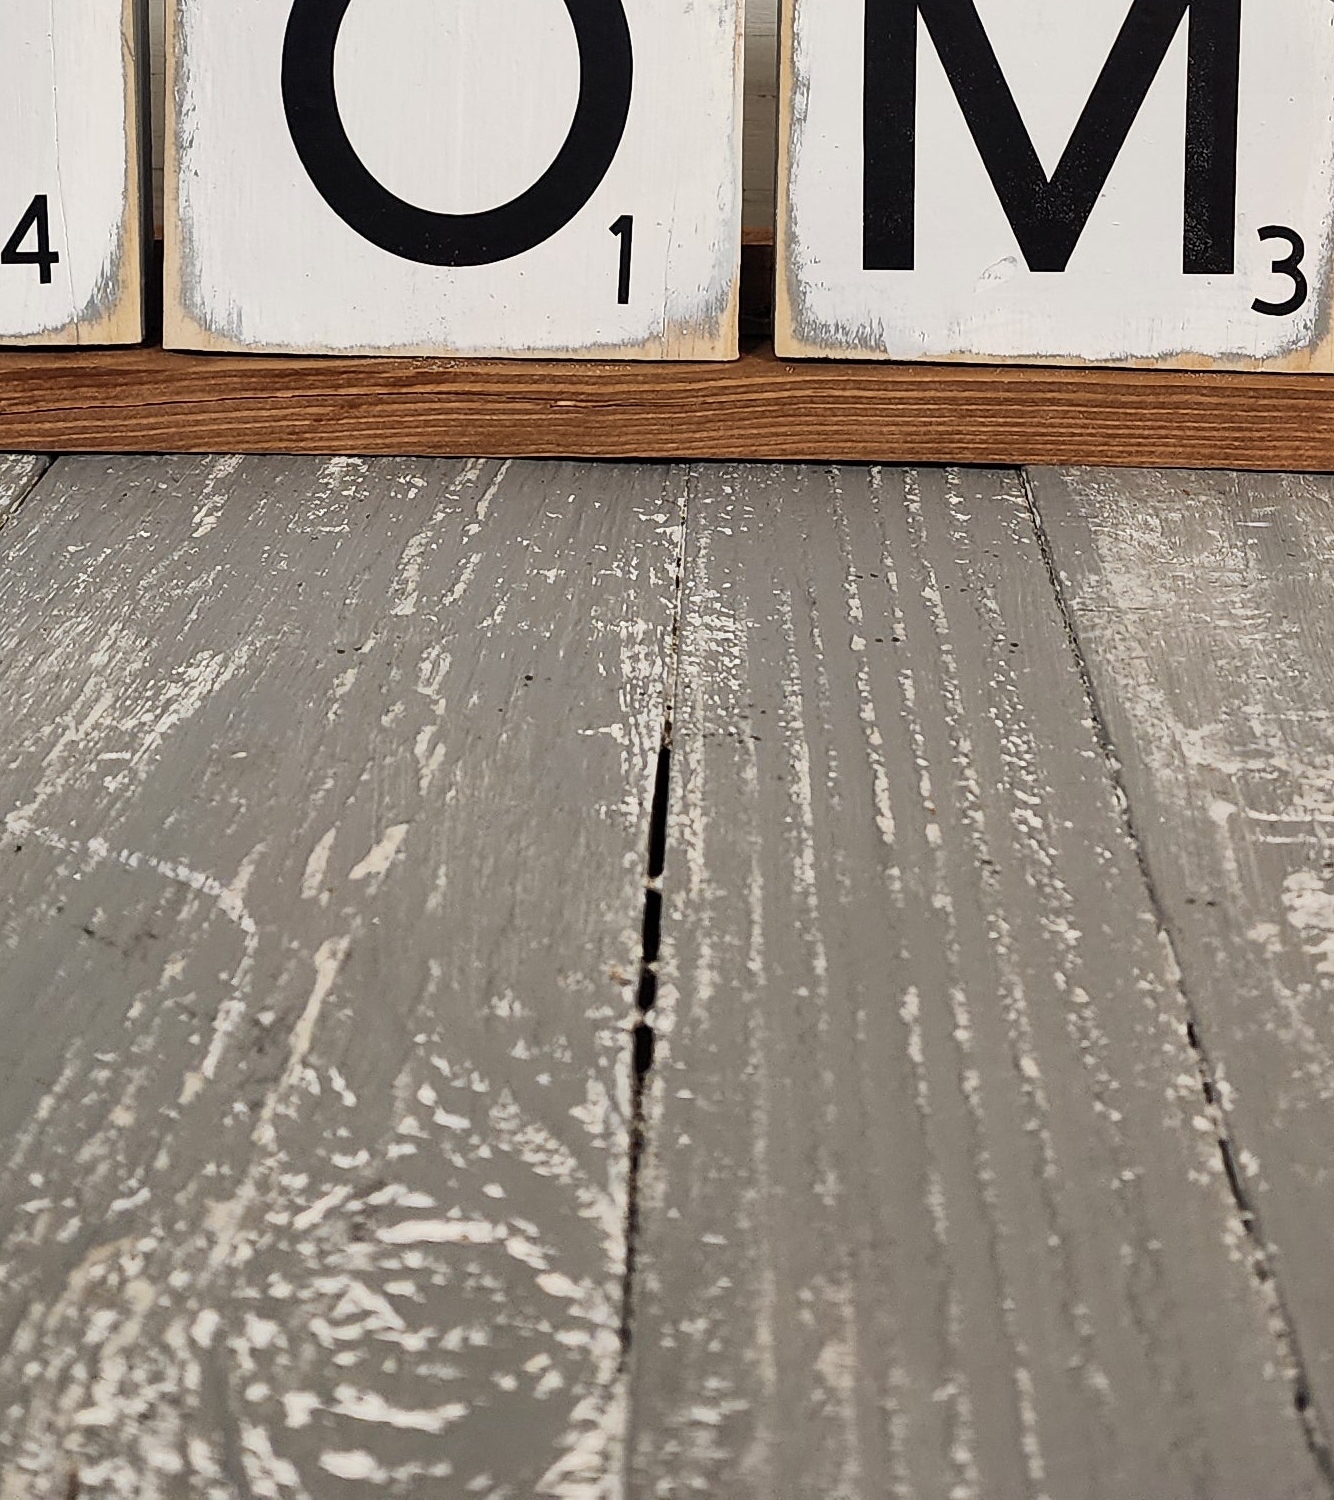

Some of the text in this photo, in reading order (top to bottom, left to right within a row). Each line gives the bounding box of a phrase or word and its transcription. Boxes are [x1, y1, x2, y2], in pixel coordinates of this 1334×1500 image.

[1, 195, 59, 284] 4
[609, 215, 633, 304] 1
[1251, 225, 1307, 316] 3
